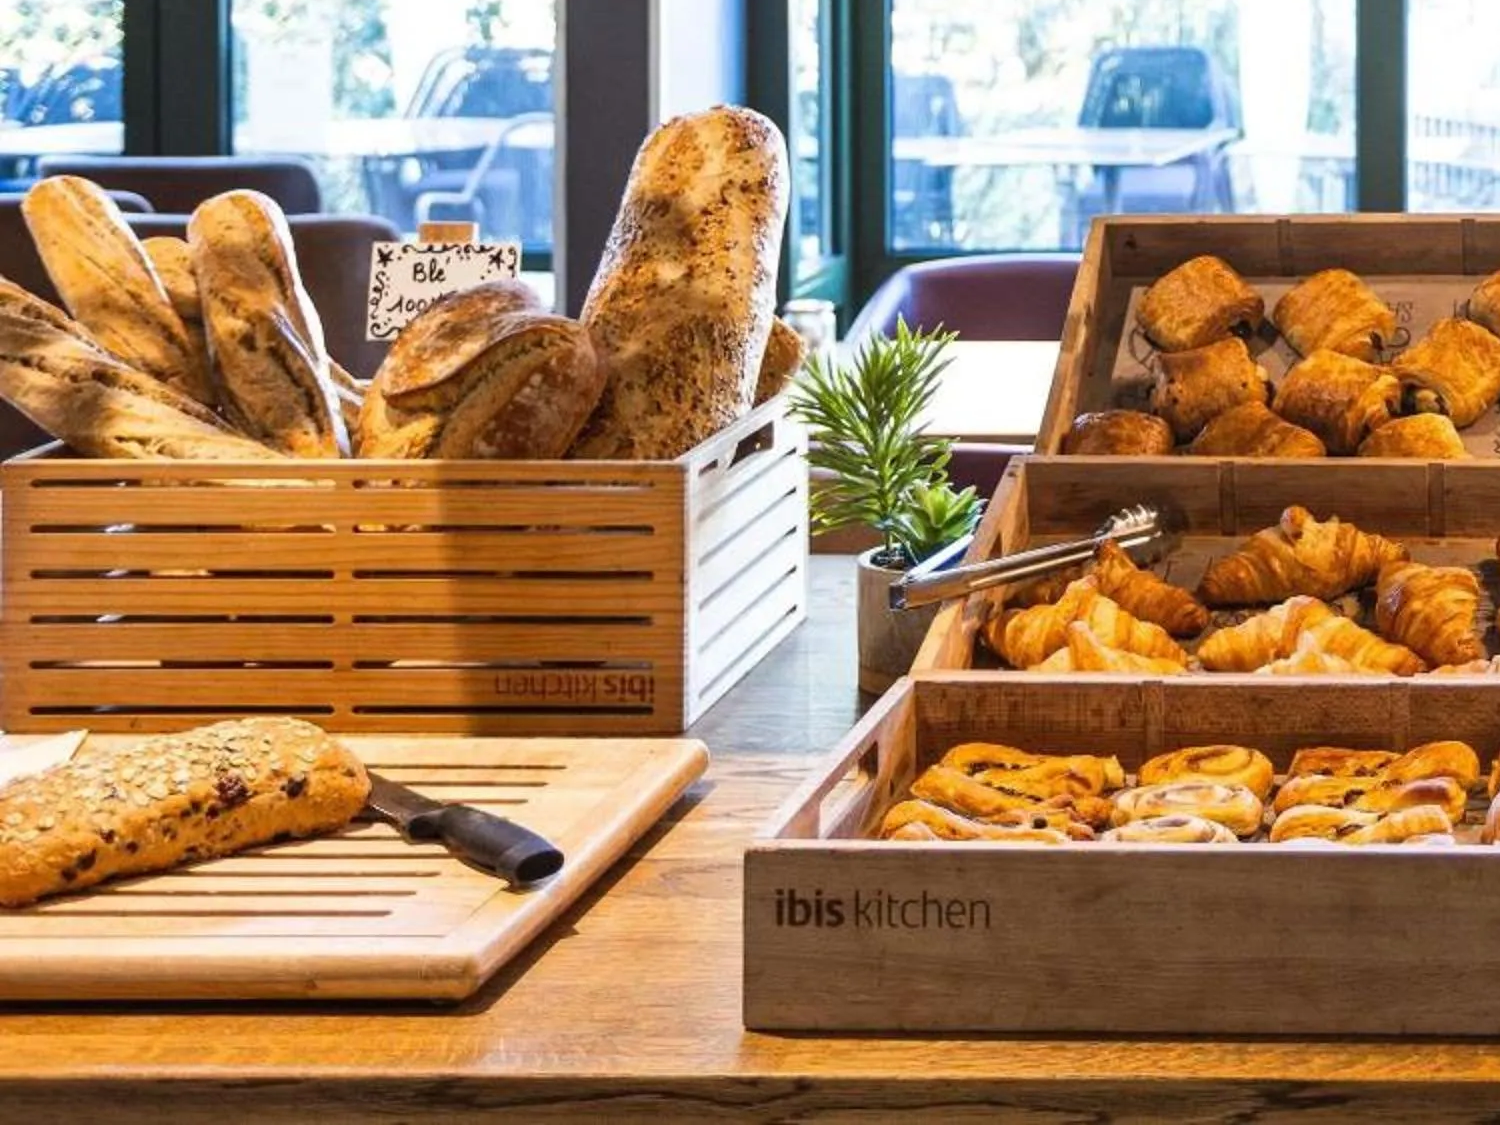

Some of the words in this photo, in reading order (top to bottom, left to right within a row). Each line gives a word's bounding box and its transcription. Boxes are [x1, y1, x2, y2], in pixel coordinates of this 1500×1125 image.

[413, 257, 447, 283] Blé
[603, 675, 655, 704] ibis
[774, 888, 845, 928] ibis
[854, 890, 991, 928] kitchen
